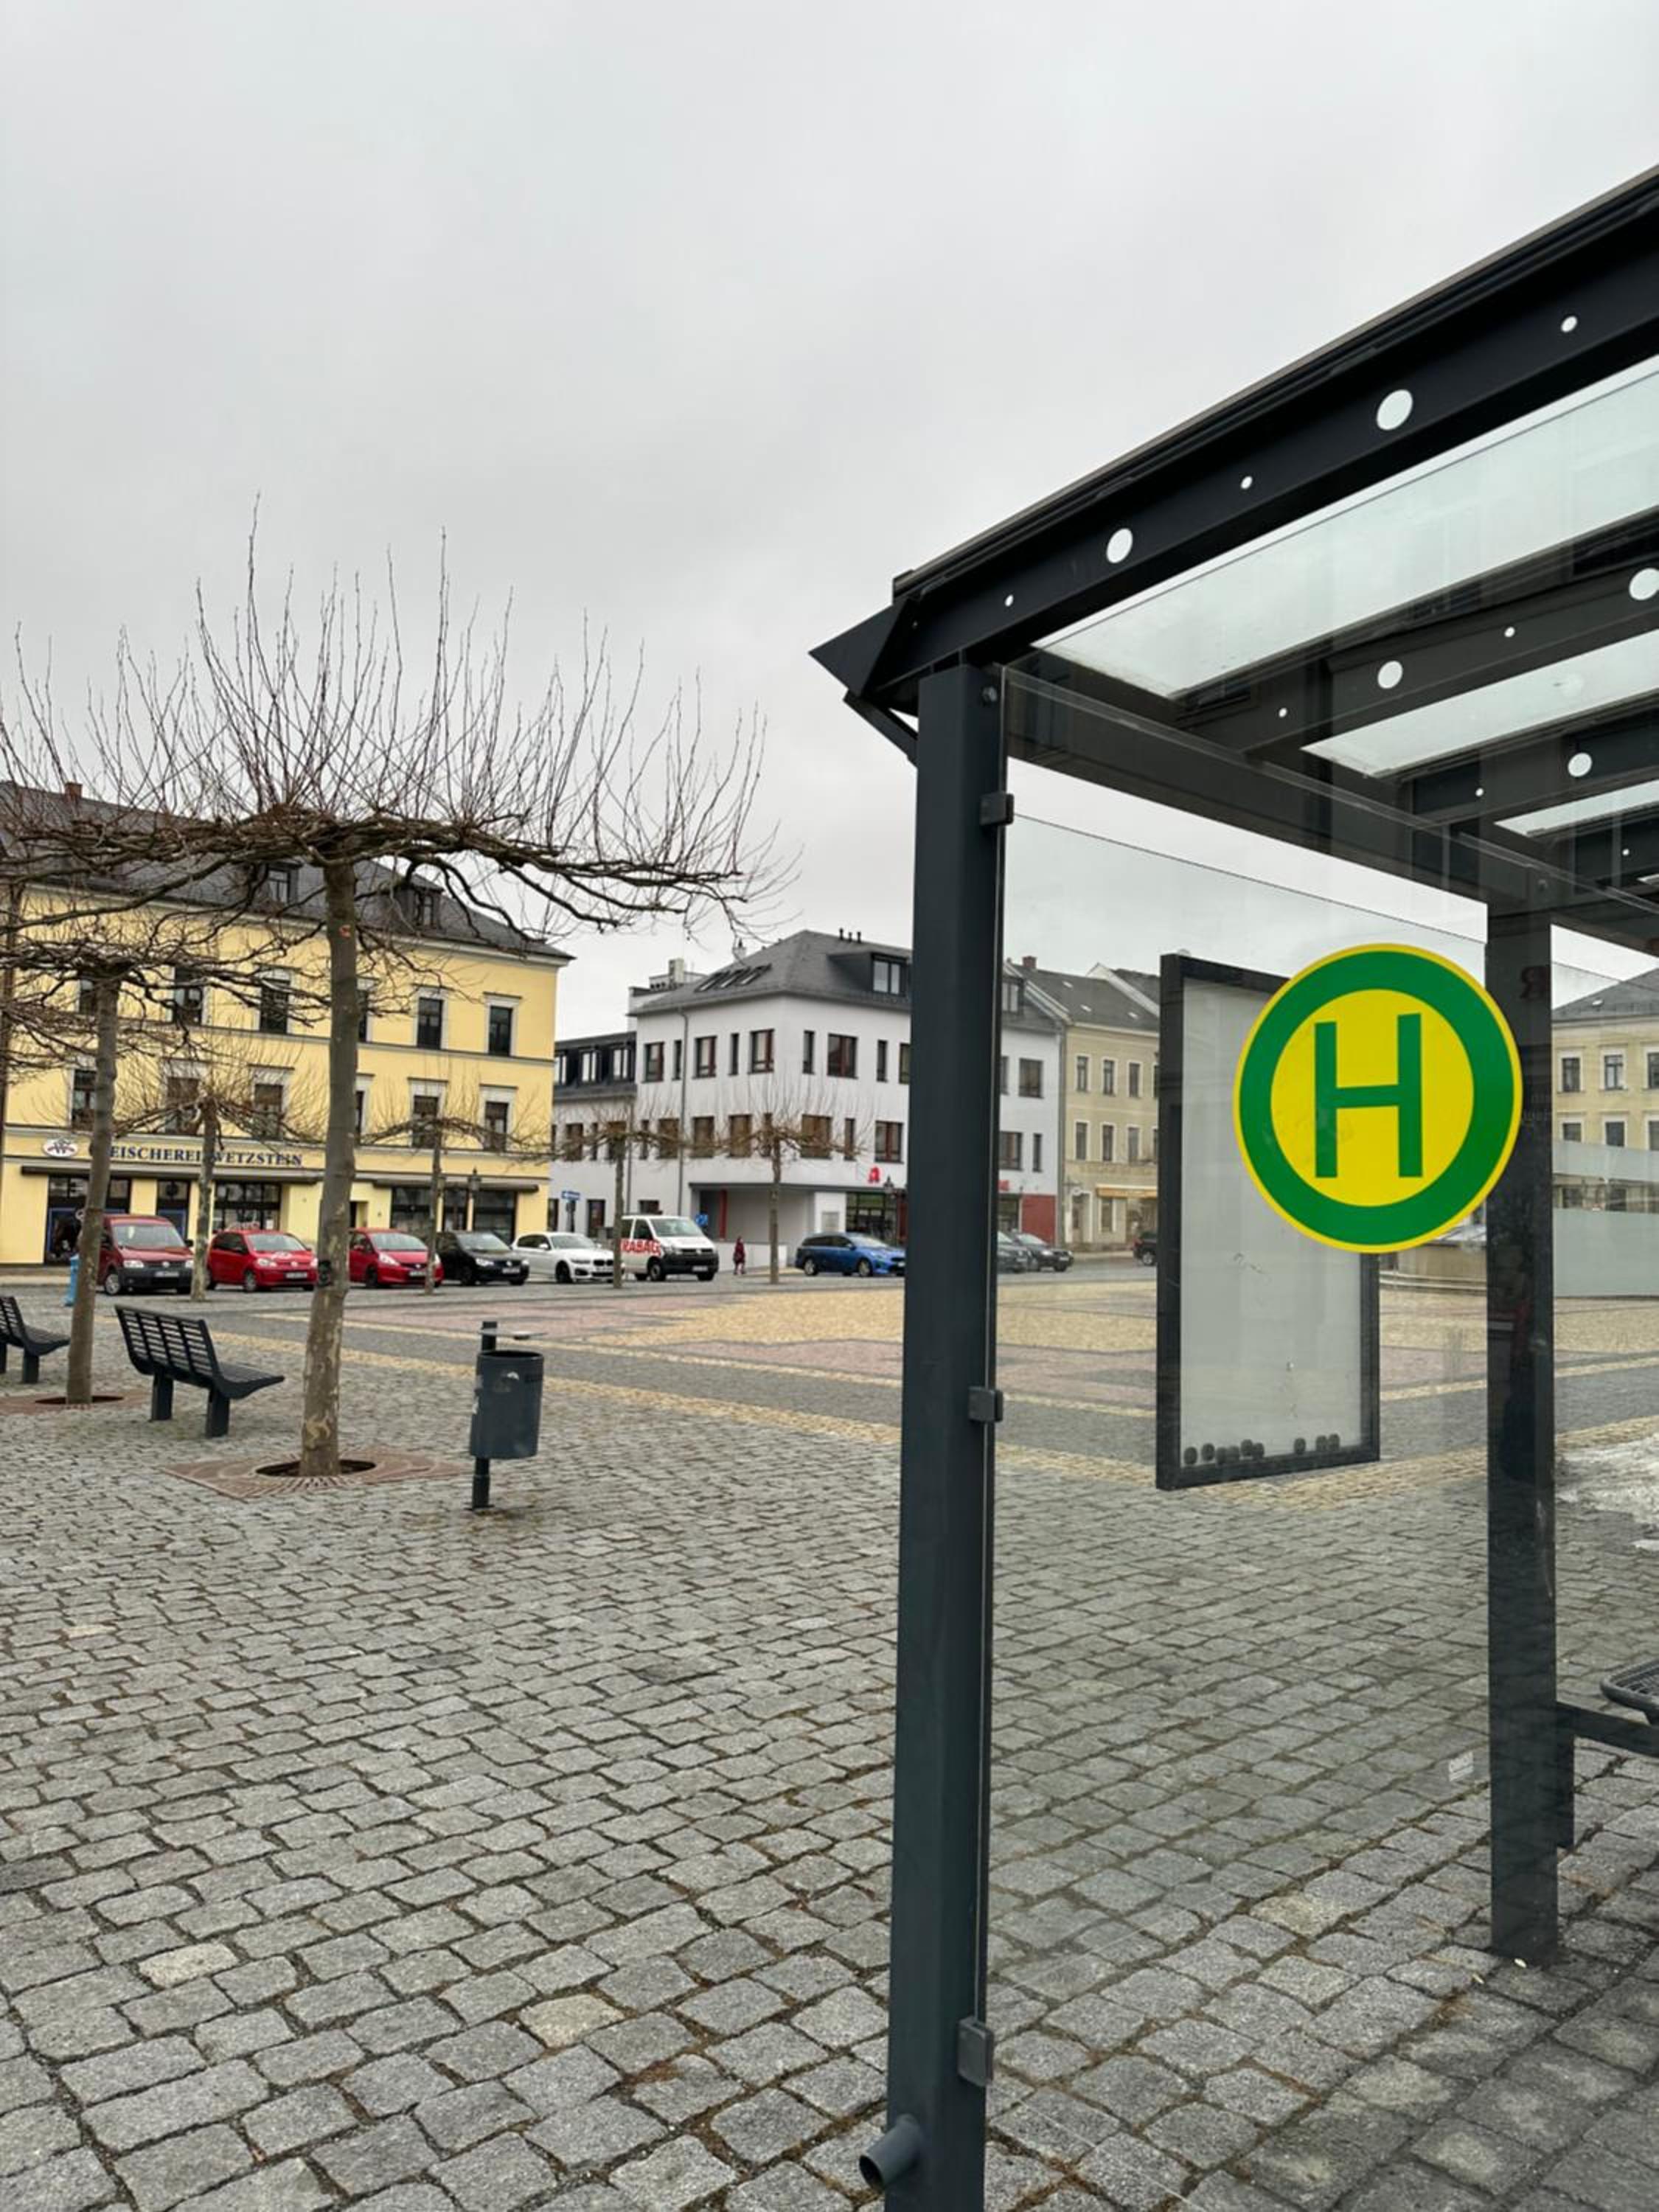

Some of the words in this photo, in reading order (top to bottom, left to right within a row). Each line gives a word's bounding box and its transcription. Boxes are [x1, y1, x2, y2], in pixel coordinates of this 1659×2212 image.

[1315, 1012, 1423, 1178] H
[89, 1144, 201, 1162] EISCHEREI
[621, 1239, 661, 1255] RABAG
